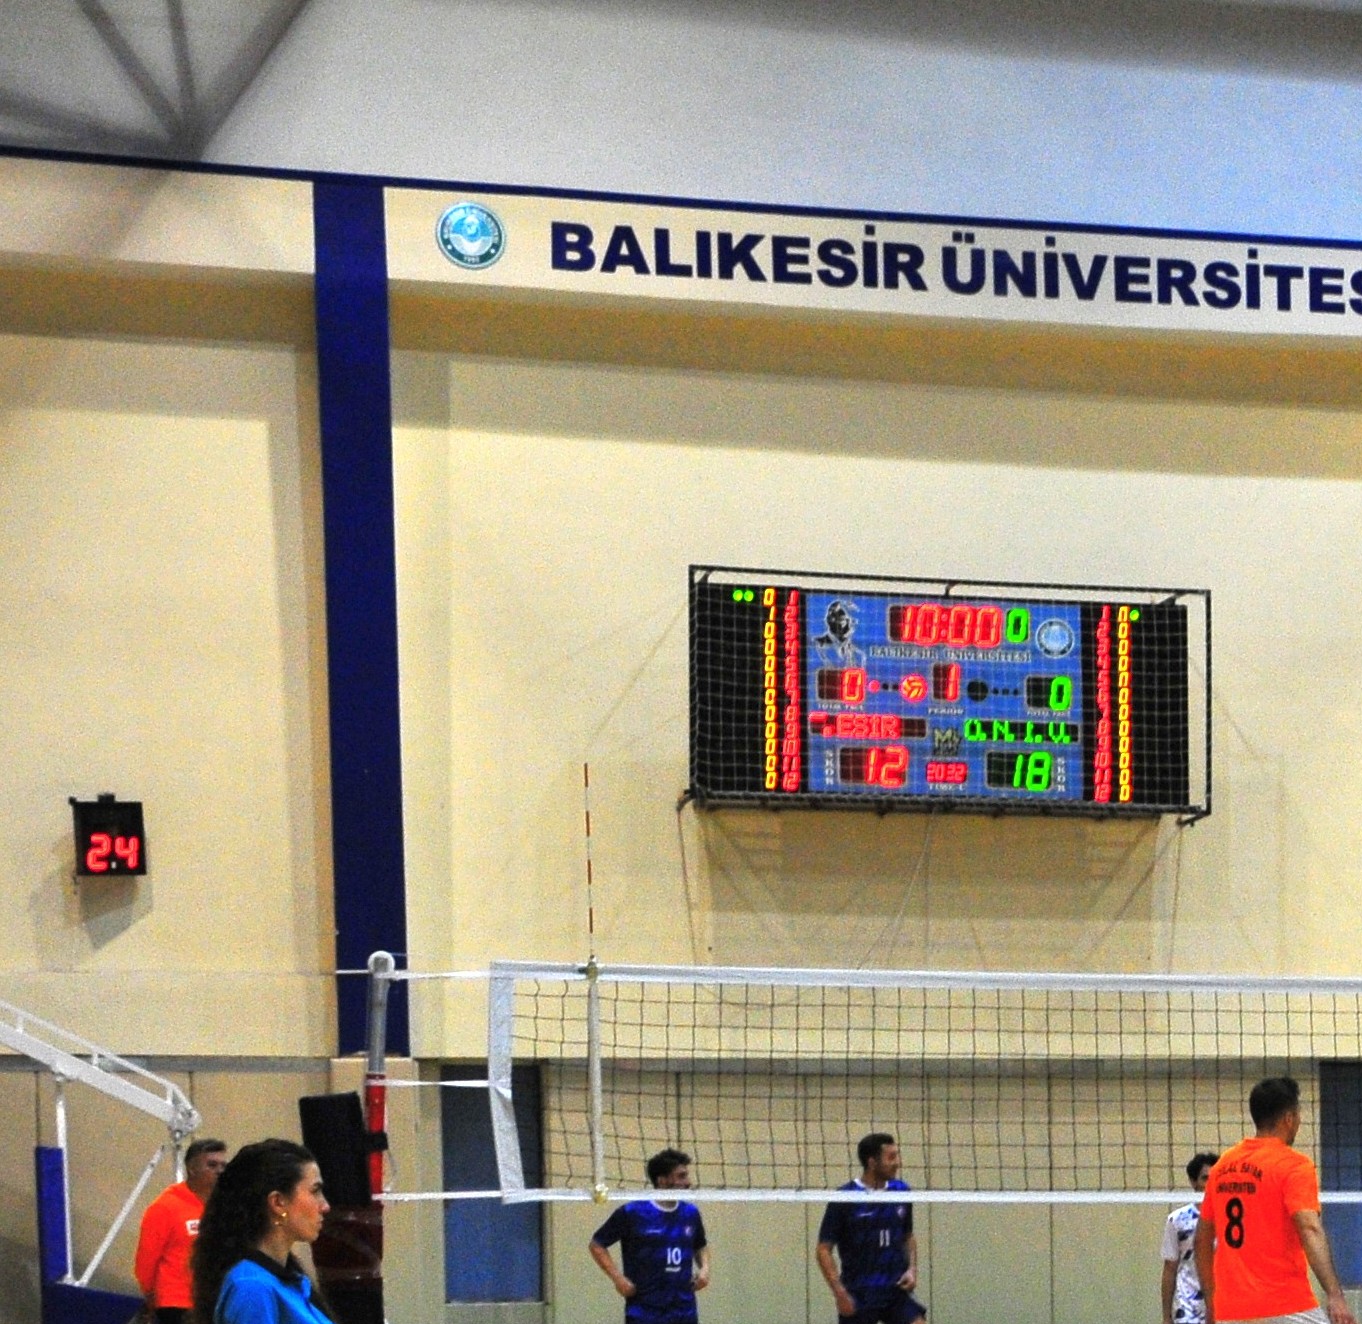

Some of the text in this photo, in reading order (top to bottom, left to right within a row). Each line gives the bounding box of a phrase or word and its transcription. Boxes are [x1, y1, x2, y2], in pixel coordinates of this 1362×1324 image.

[551, 221, 928, 291] BALIKESİR
[841, 667, 866, 705] 0
[1050, 676, 1072, 711] 0
[865, 745, 909, 788] 12
[1013, 751, 1052, 792] 18
[86, 833, 139, 872] 24
[880, 1229, 890, 1247] 11
[1225, 1197, 1244, 1249] 8
[667, 1247, 681, 1265] 10
